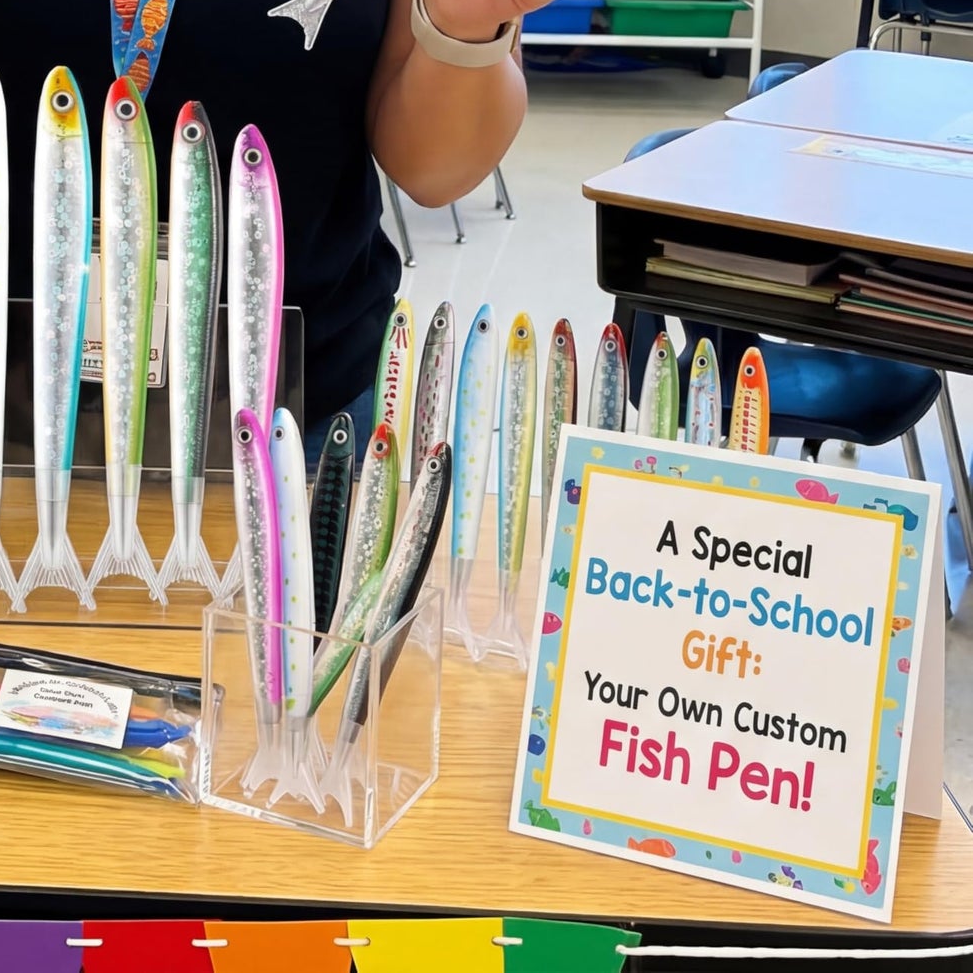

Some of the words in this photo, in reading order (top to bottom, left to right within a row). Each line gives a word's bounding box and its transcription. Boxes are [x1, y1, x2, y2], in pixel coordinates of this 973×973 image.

[656, 520, 679, 556] A
[692, 525, 812, 579] Special
[585, 557, 875, 646] Back-to-School
[681, 629, 762, 678] Gift:
[584, 670, 648, 710] Your
[657, 685, 723, 727] Own
[733, 701, 847, 753] Custom
[599, 719, 691, 785] Fish
[708, 741, 815, 812] Pen!
